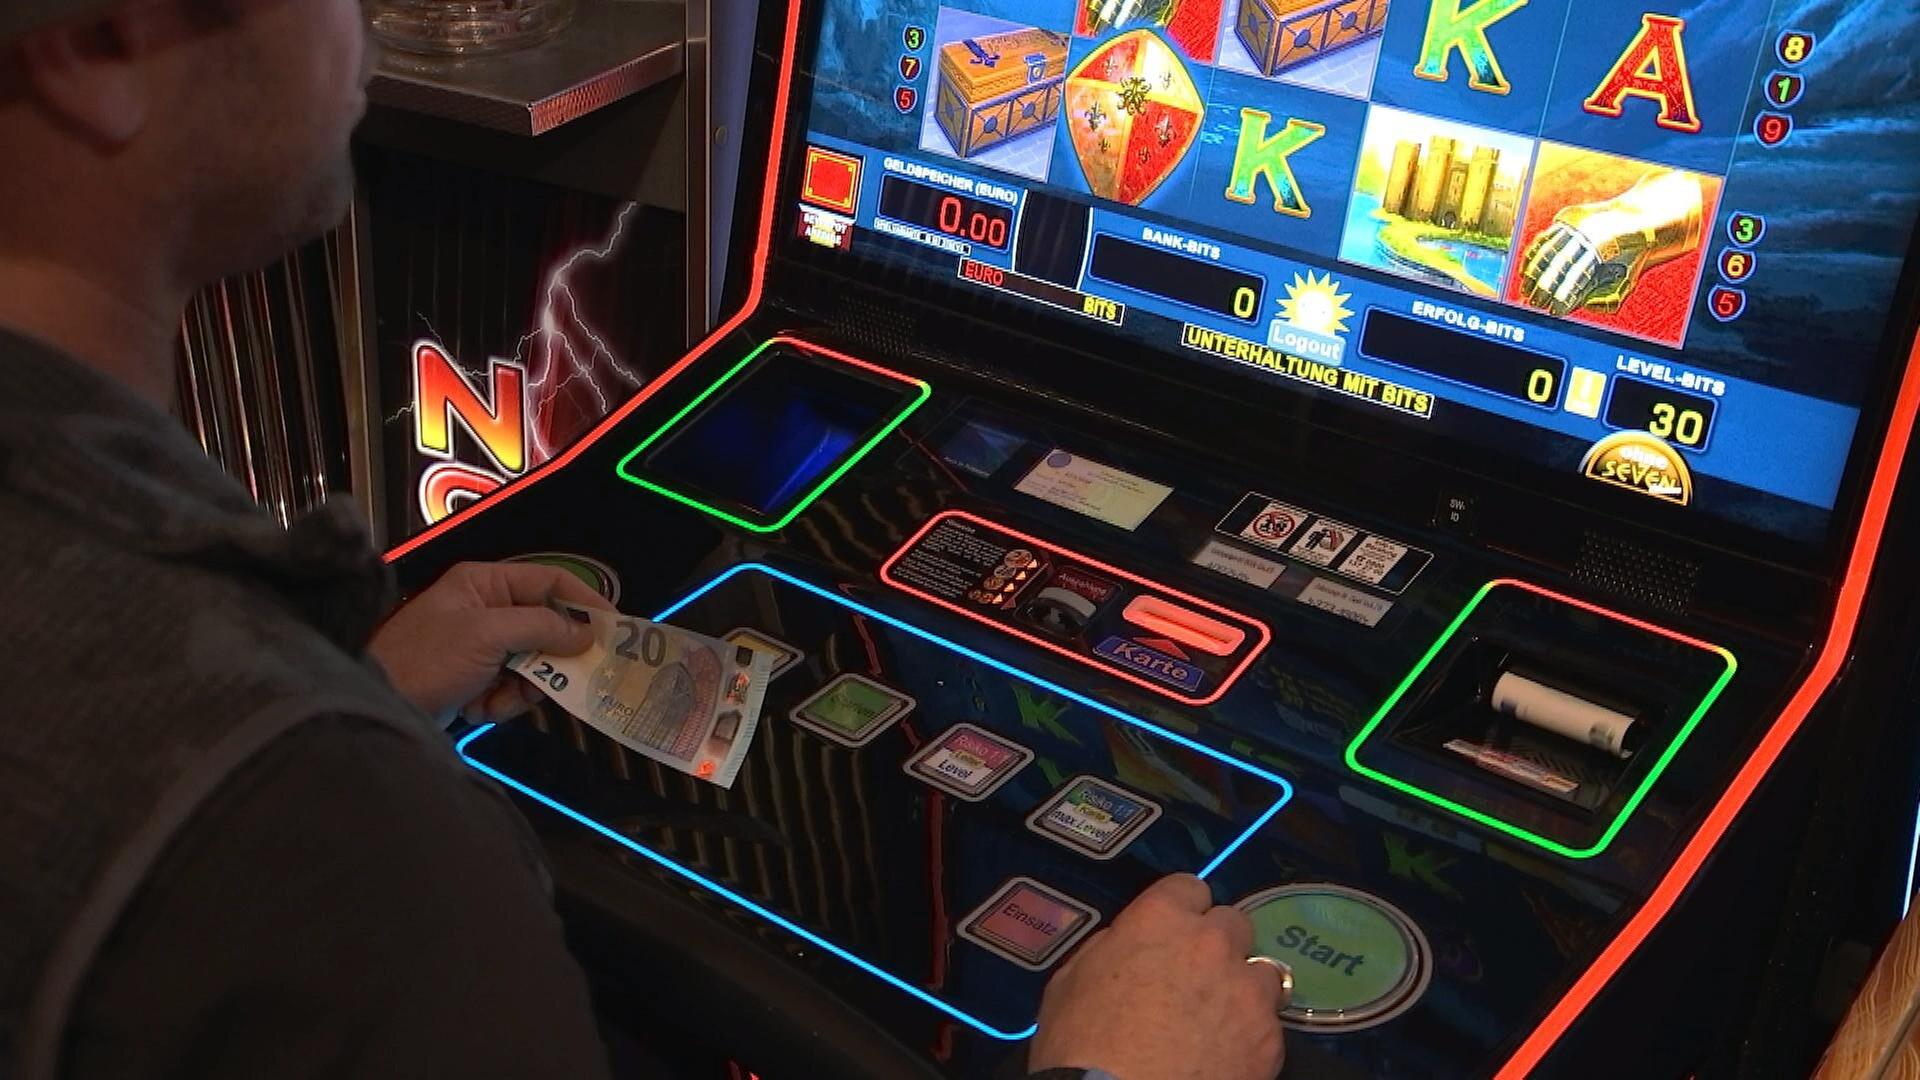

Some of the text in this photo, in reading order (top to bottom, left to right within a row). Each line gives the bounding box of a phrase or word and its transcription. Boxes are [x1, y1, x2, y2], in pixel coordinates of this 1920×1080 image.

[907, 29, 919, 49] 3
[1413, 0, 1530, 95] K
[1784, 35, 1806, 62] 8
[904, 59, 916, 77] 7
[1583, 13, 1702, 133] A
[899, 89, 912, 109] 5
[1776, 76, 1792, 103] 1
[1762, 118, 1781, 142] 9
[1225, 107, 1326, 218] K
[883, 157, 1018, 206] GELDSPEICHER (EURO)
[938, 196, 1006, 248] 0.00
[1734, 216, 1755, 243] 3
[1142, 226, 1221, 260] BANK-BITS
[965, 260, 1004, 286] EURO
[1726, 254, 1745, 278] 6
[1083, 295, 1117, 320] BITS
[1233, 286, 1255, 318] 0
[1716, 292, 1735, 315] 5
[1412, 300, 1525, 343] ERFOLG-BITS
[1271, 323, 1342, 361] Logout
[1187, 326, 1429, 413] UNTERHALTUNG MIT BITS
[1527, 368, 1553, 403] 0
[1615, 354, 1726, 397] LEVEL-BITS
[412, 341, 529, 476] N
[1649, 402, 1704, 445] 30
[615, 621, 667, 668] 20
[1112, 641, 1190, 682] Karte
[531, 660, 569, 692] 20
[600, 693, 635, 718] EURO
[937, 758, 974, 781] Level
[1002, 902, 1060, 937] Einsatz
[1275, 925, 1365, 977] Start
